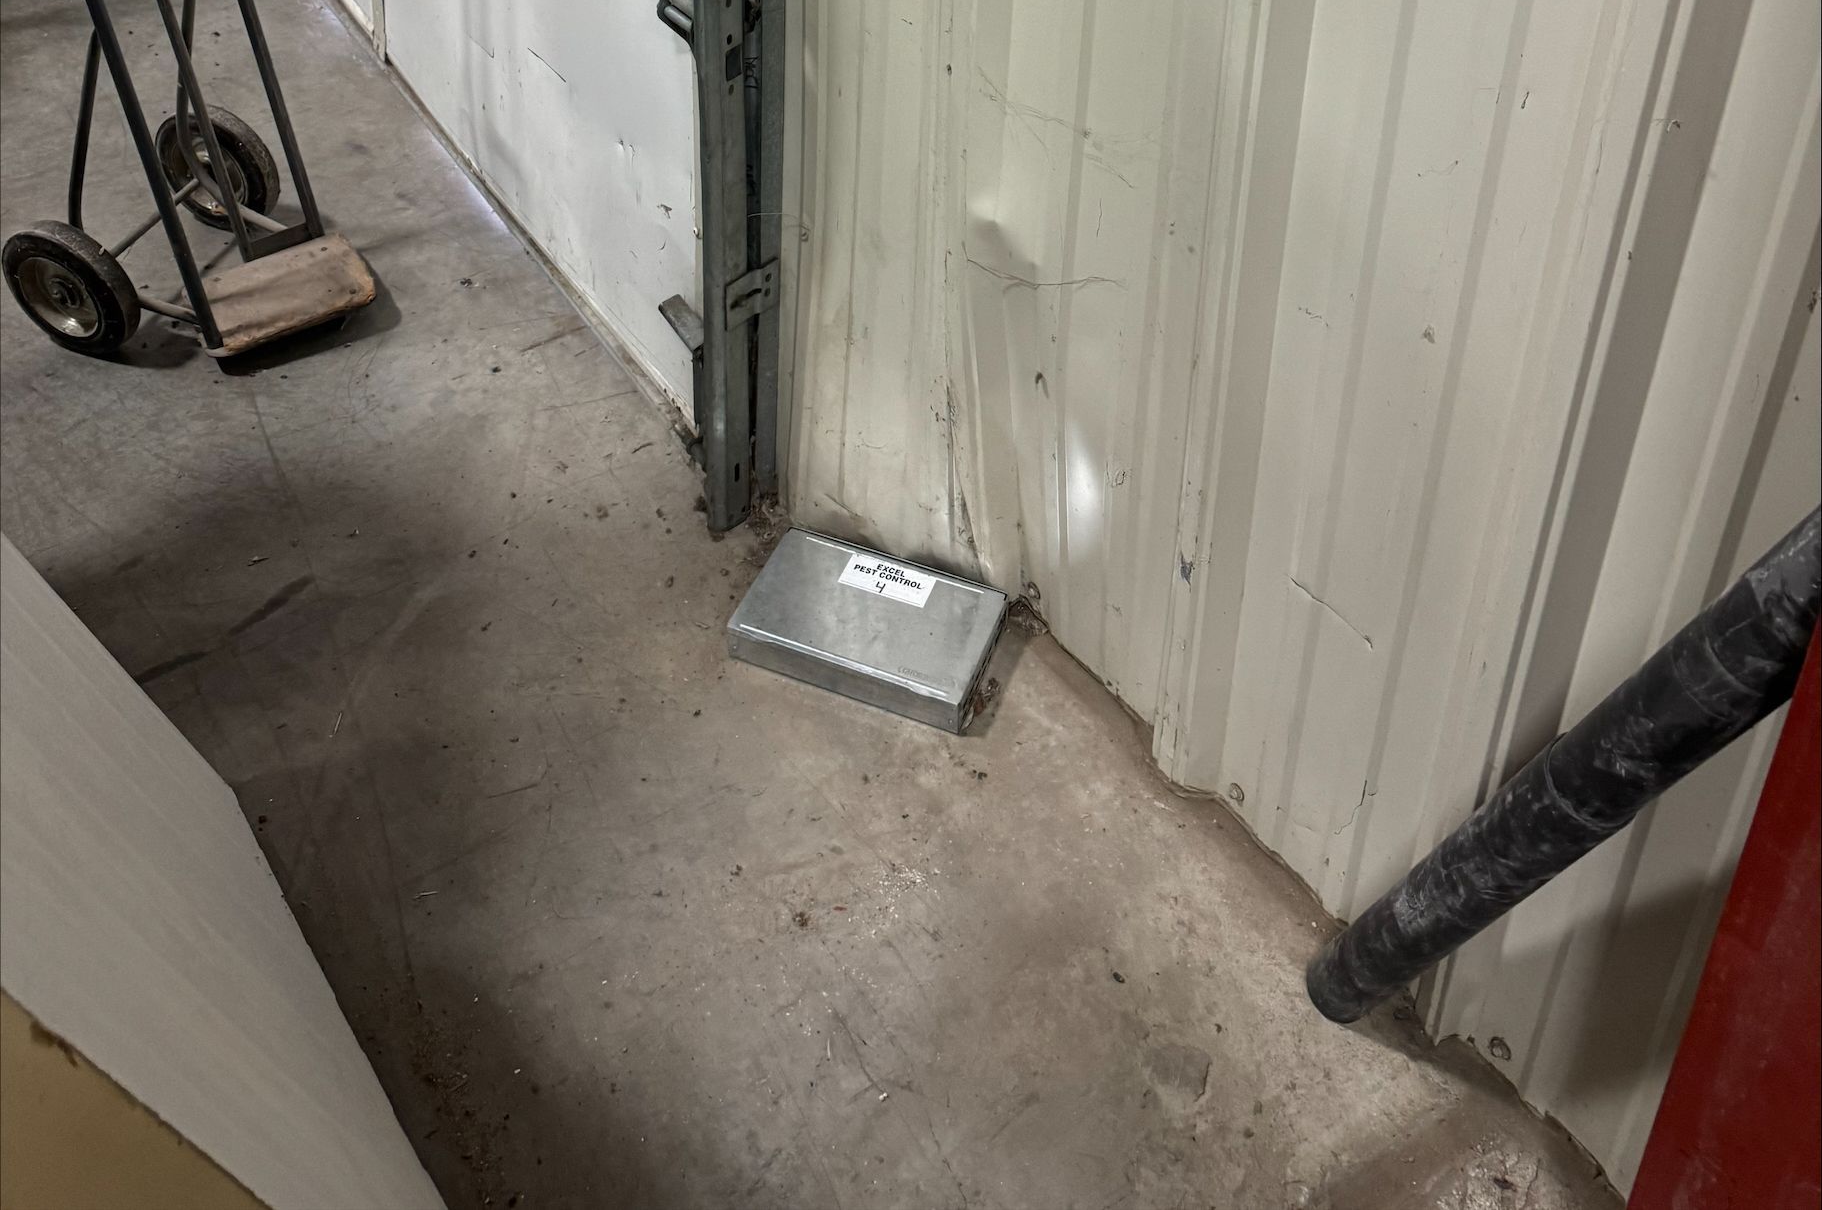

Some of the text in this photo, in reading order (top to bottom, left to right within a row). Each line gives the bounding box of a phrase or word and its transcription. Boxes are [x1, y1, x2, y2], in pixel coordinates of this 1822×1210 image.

[853, 564, 922, 590] PEST CONTROL
[876, 563, 905, 578] EXCEL
[876, 581, 886, 593] 4
